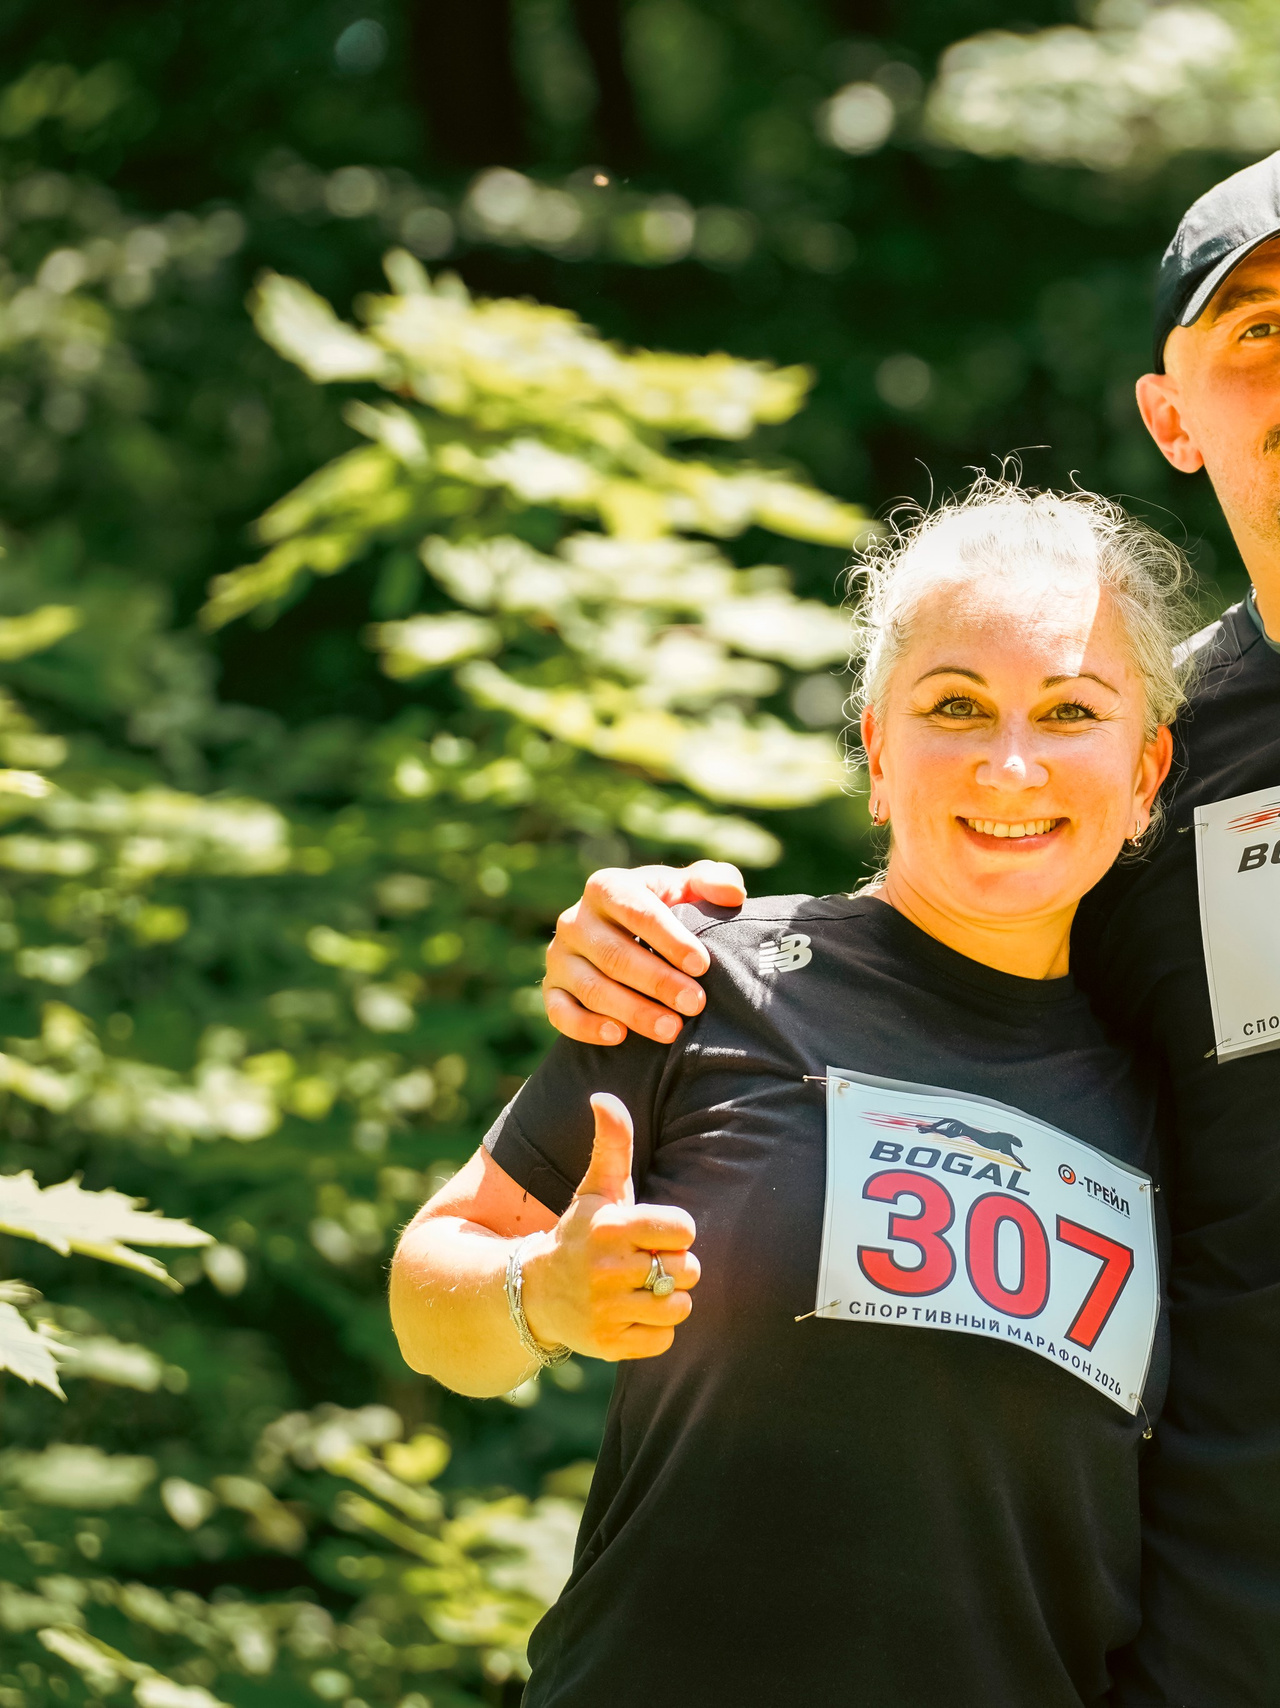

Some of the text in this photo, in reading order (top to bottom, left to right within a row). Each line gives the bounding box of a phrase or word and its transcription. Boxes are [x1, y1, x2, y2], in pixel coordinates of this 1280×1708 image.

[869, 1140, 1031, 1196] BOGAL
[857, 1168, 1134, 1352] 307
[849, 1301, 1121, 1396] СПОРТИВНЫЙ МАРАФОН 2026
